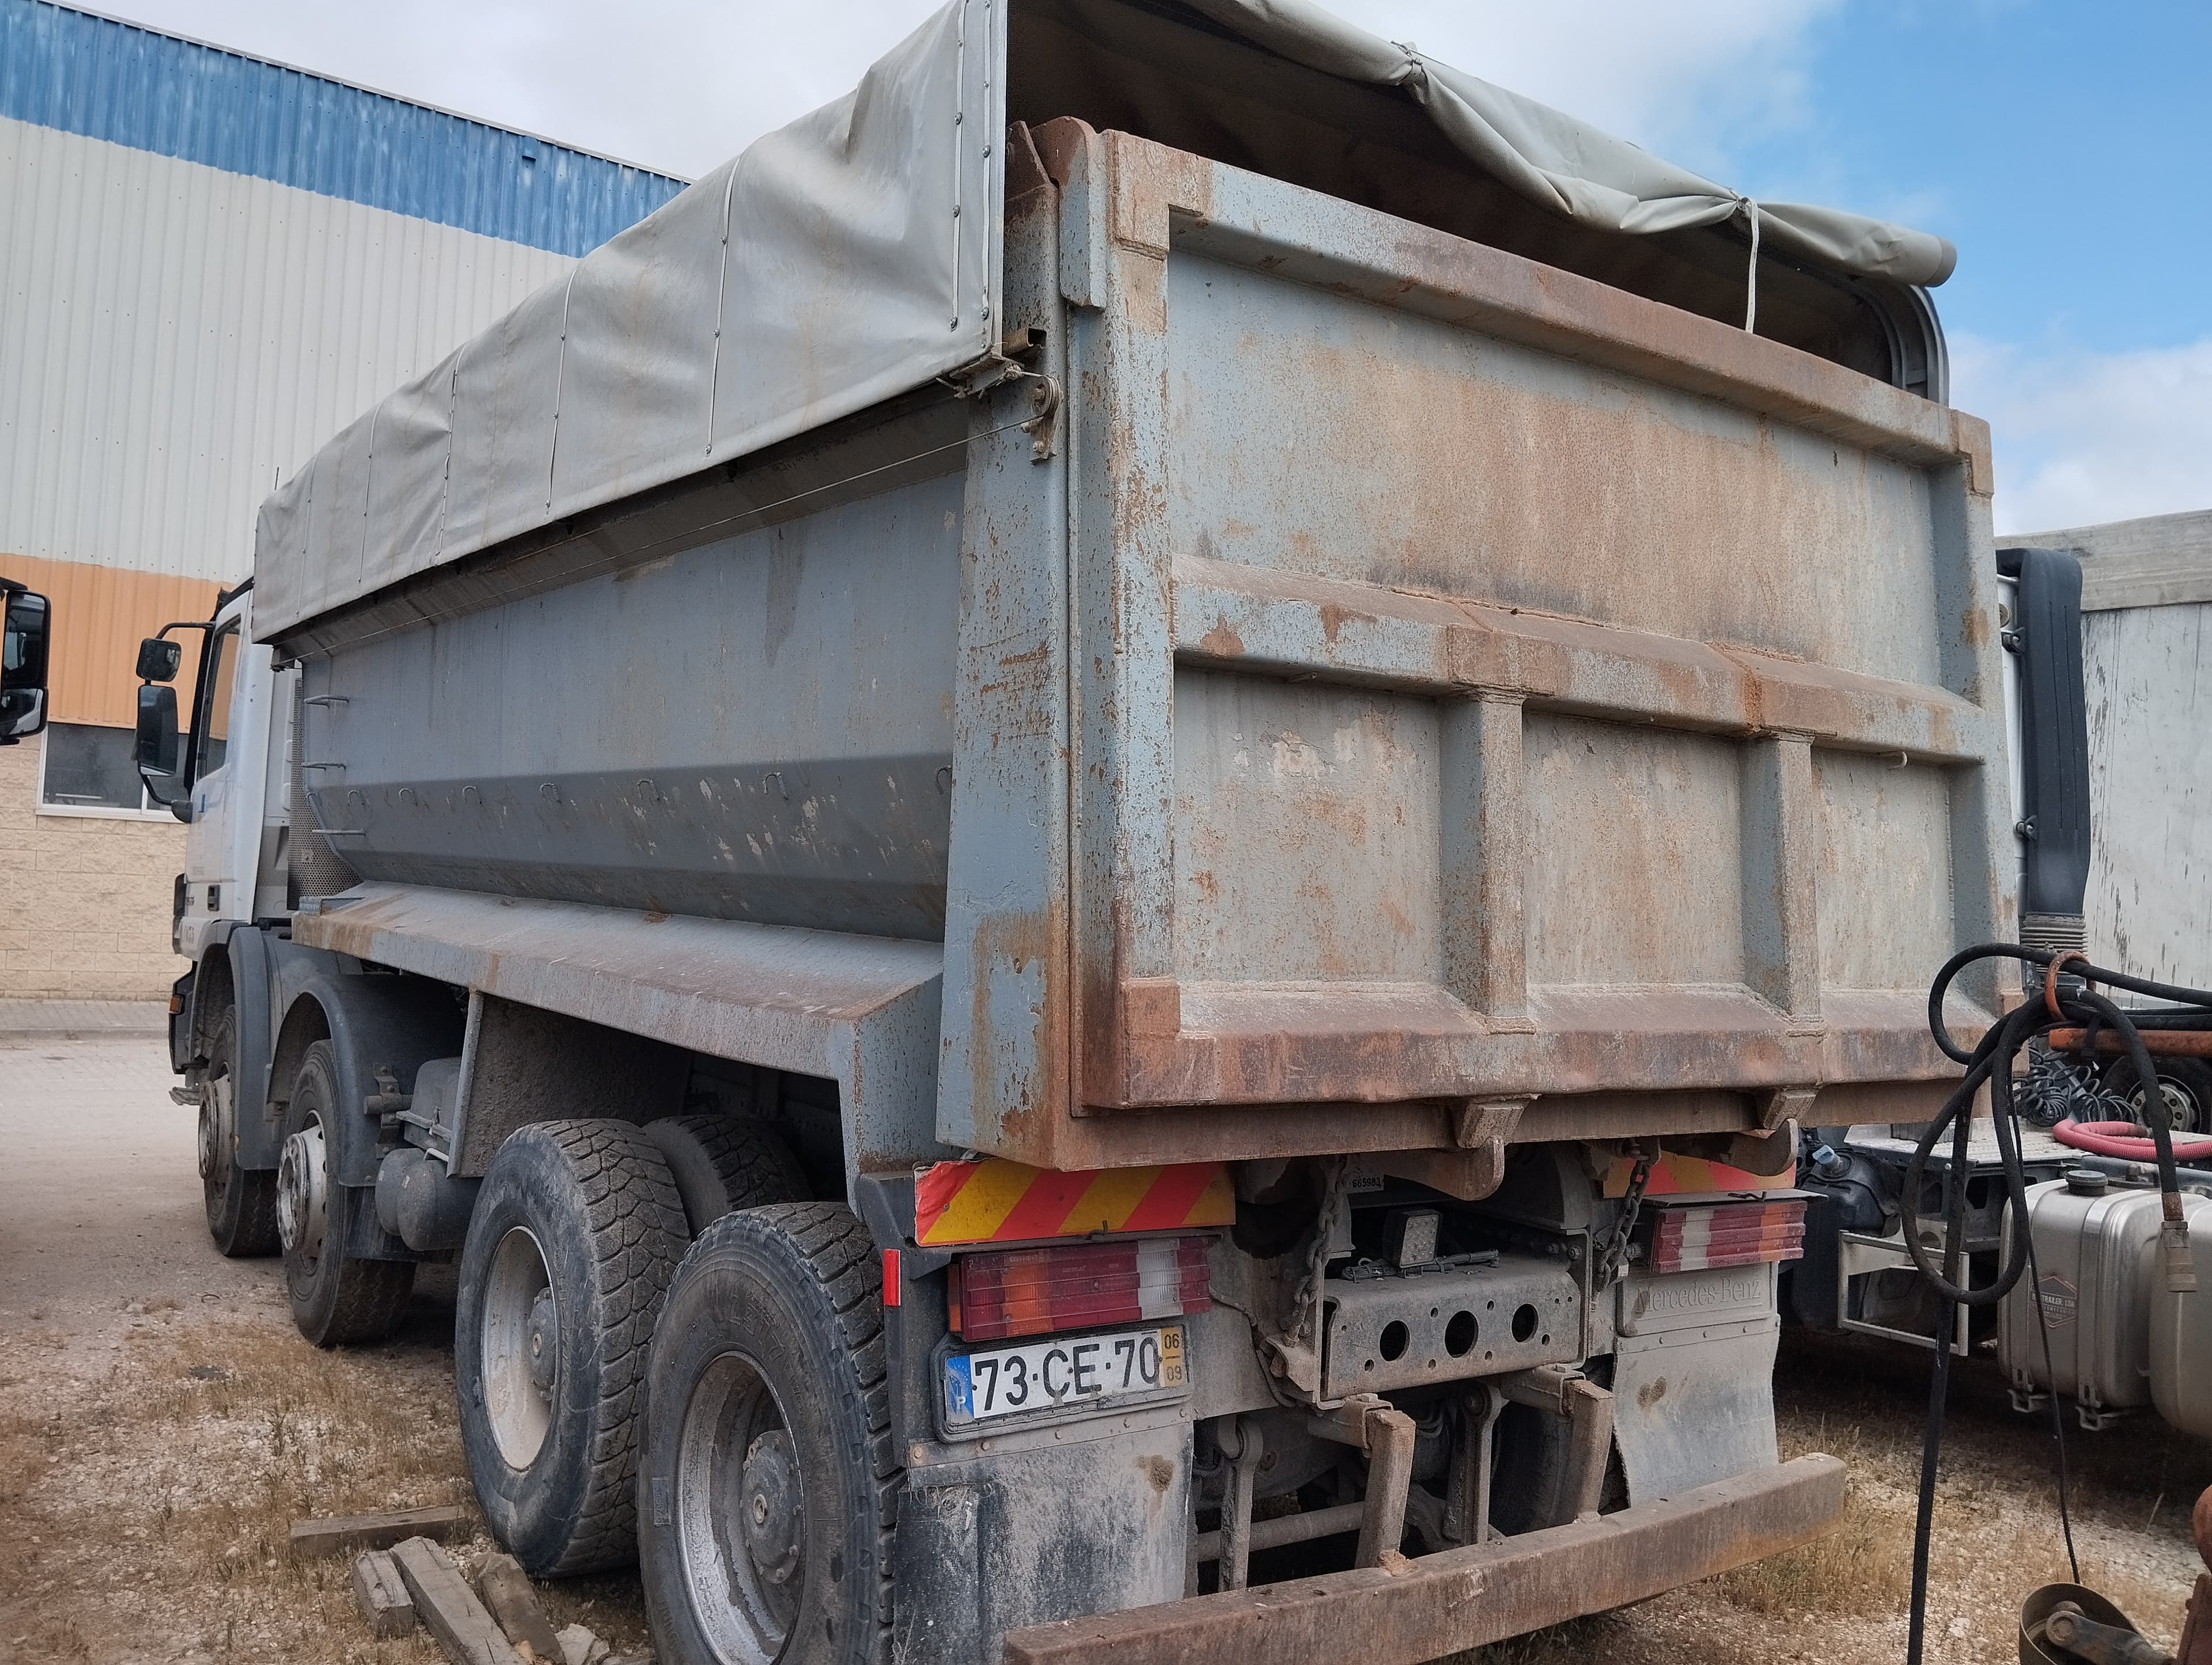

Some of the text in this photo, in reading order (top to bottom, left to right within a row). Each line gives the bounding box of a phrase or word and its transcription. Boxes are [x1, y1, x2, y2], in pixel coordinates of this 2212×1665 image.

[1635, 1276, 1761, 1313] Mercedes-Benz
[1164, 1333, 1180, 1349] 06
[1166, 1365, 1182, 1381] 09
[955, 1395, 967, 1410] P
